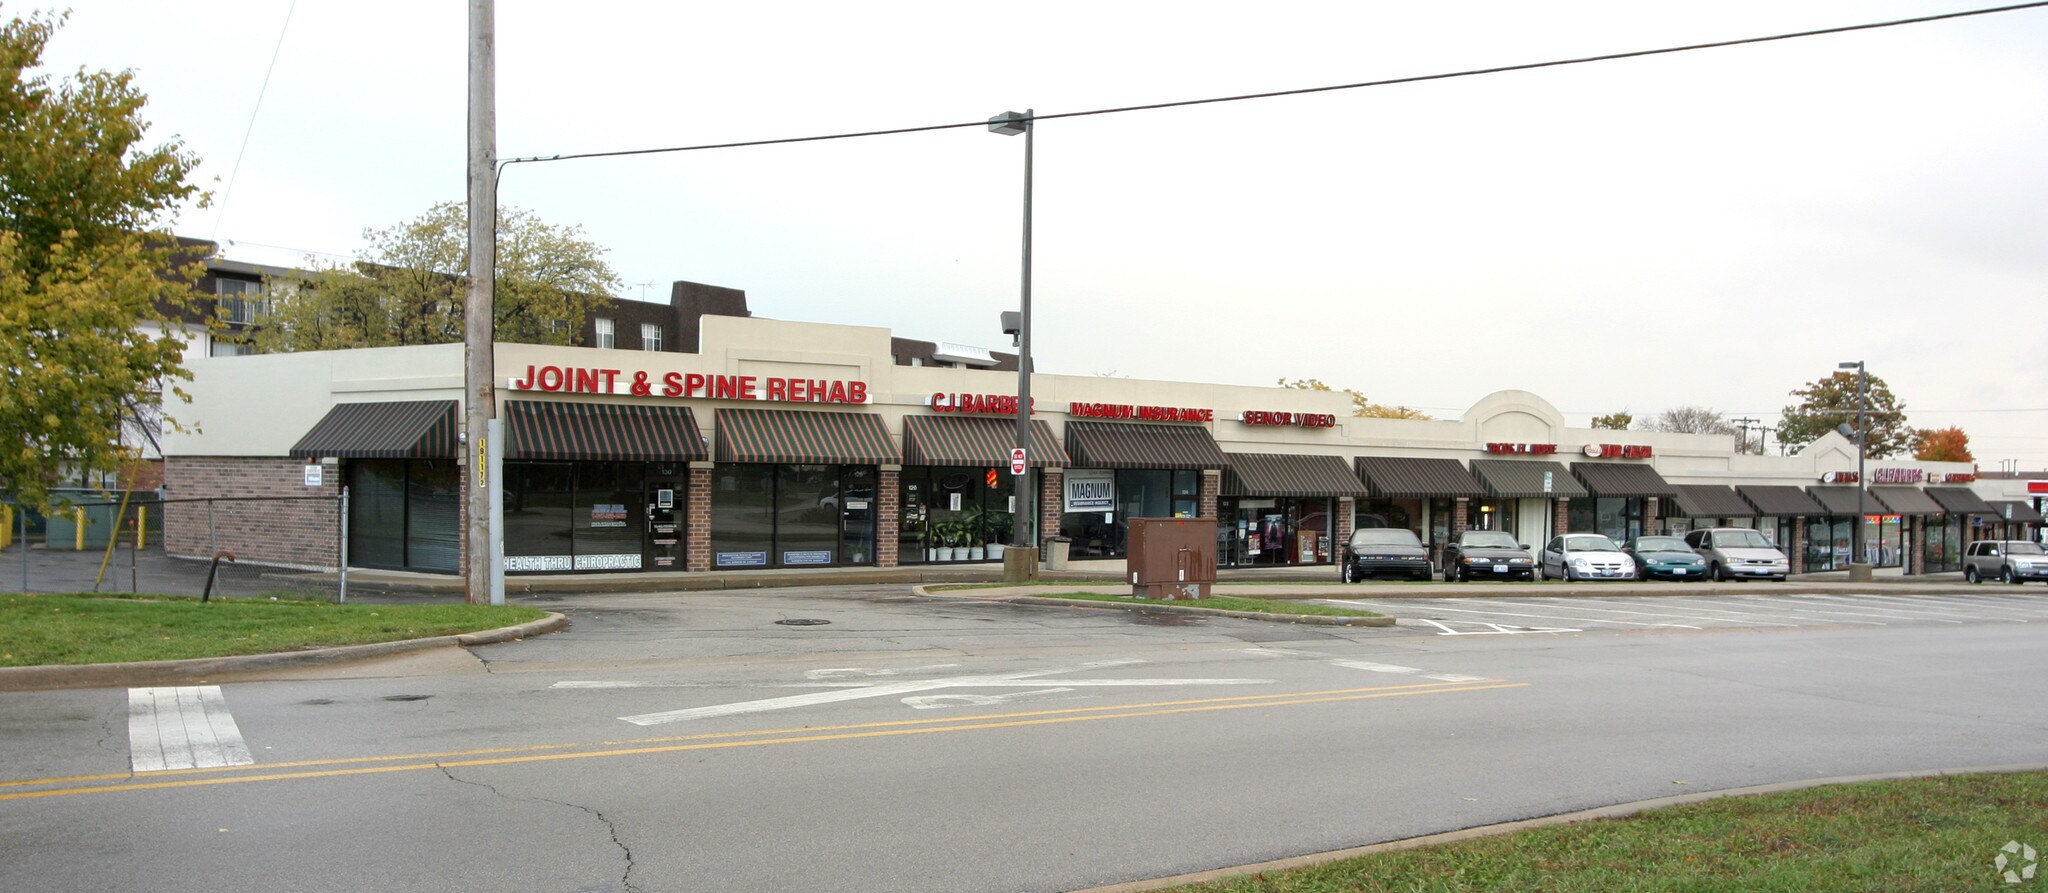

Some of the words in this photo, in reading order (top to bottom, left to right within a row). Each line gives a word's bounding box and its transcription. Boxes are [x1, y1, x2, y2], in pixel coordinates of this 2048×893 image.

[515, 364, 621, 395] JOINT
[631, 370, 652, 398] &
[663, 371, 757, 401] SPINE
[767, 376, 868, 405] REHAB
[1071, 402, 1134, 419] MAGNUM
[1138, 405, 1214, 423] INSURANCE
[1295, 413, 1336, 429] VIDEO
[1071, 482, 1111, 499] MAGNUM
[504, 556, 543, 570] HEALTH
[544, 556, 571, 569] THRU
[575, 554, 641, 569] CHIROPRACTIC
